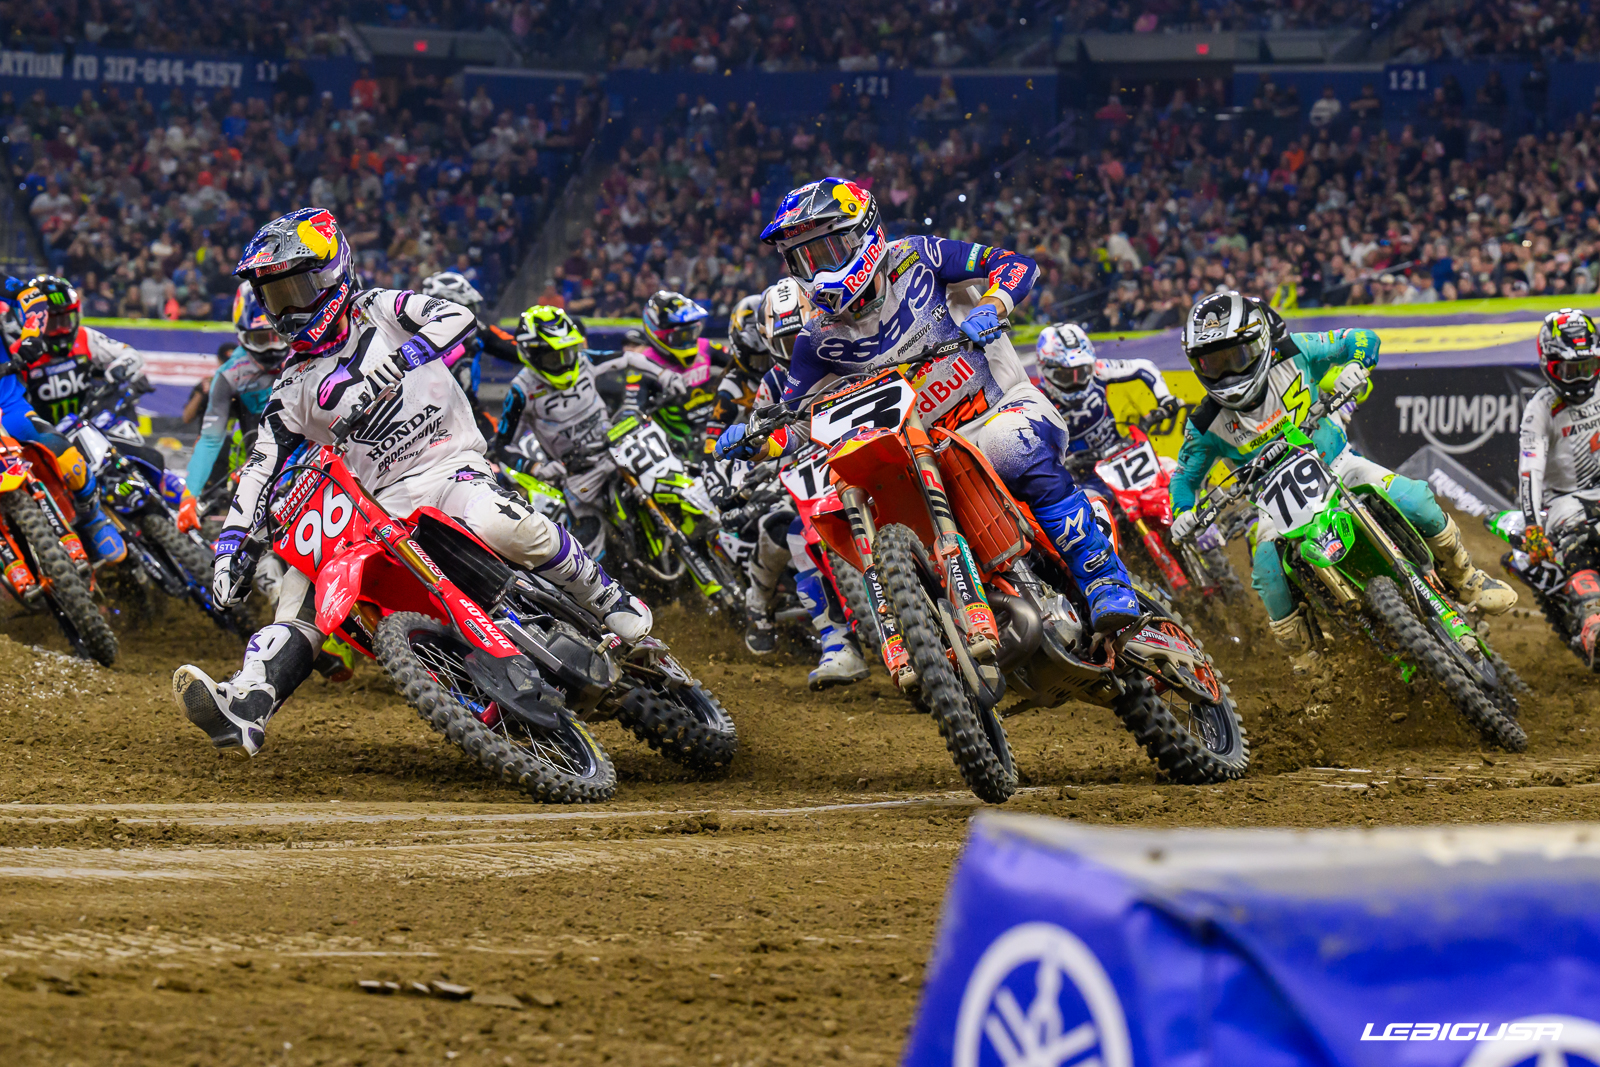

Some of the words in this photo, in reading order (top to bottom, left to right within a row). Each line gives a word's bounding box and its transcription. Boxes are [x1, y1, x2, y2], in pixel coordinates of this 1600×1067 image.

[1389, 70, 1427, 90] 121
[255, 265, 271, 278] Red
[270, 260, 288, 273] Bull
[843, 253, 874, 294] Red
[866, 225, 887, 264] Bull
[307, 308, 335, 342] Red
[327, 282, 349, 315] Bull
[401, 344, 422, 368] STUD
[897, 322, 932, 357] PROGRESSIVE
[927, 356, 975, 404] Bull
[366, 404, 442, 461] HONDA
[828, 386, 902, 446] 3
[1256, 408, 1282, 432] MAXXIS
[1394, 395, 1520, 434] TRIUMPH
[625, 431, 670, 476] 20
[1113, 450, 1156, 490] 12
[280, 471, 319, 522] RENTHAL
[1263, 458, 1322, 529] 719
[294, 480, 355, 561] 96
[459, 599, 514, 650] DUNLOP
